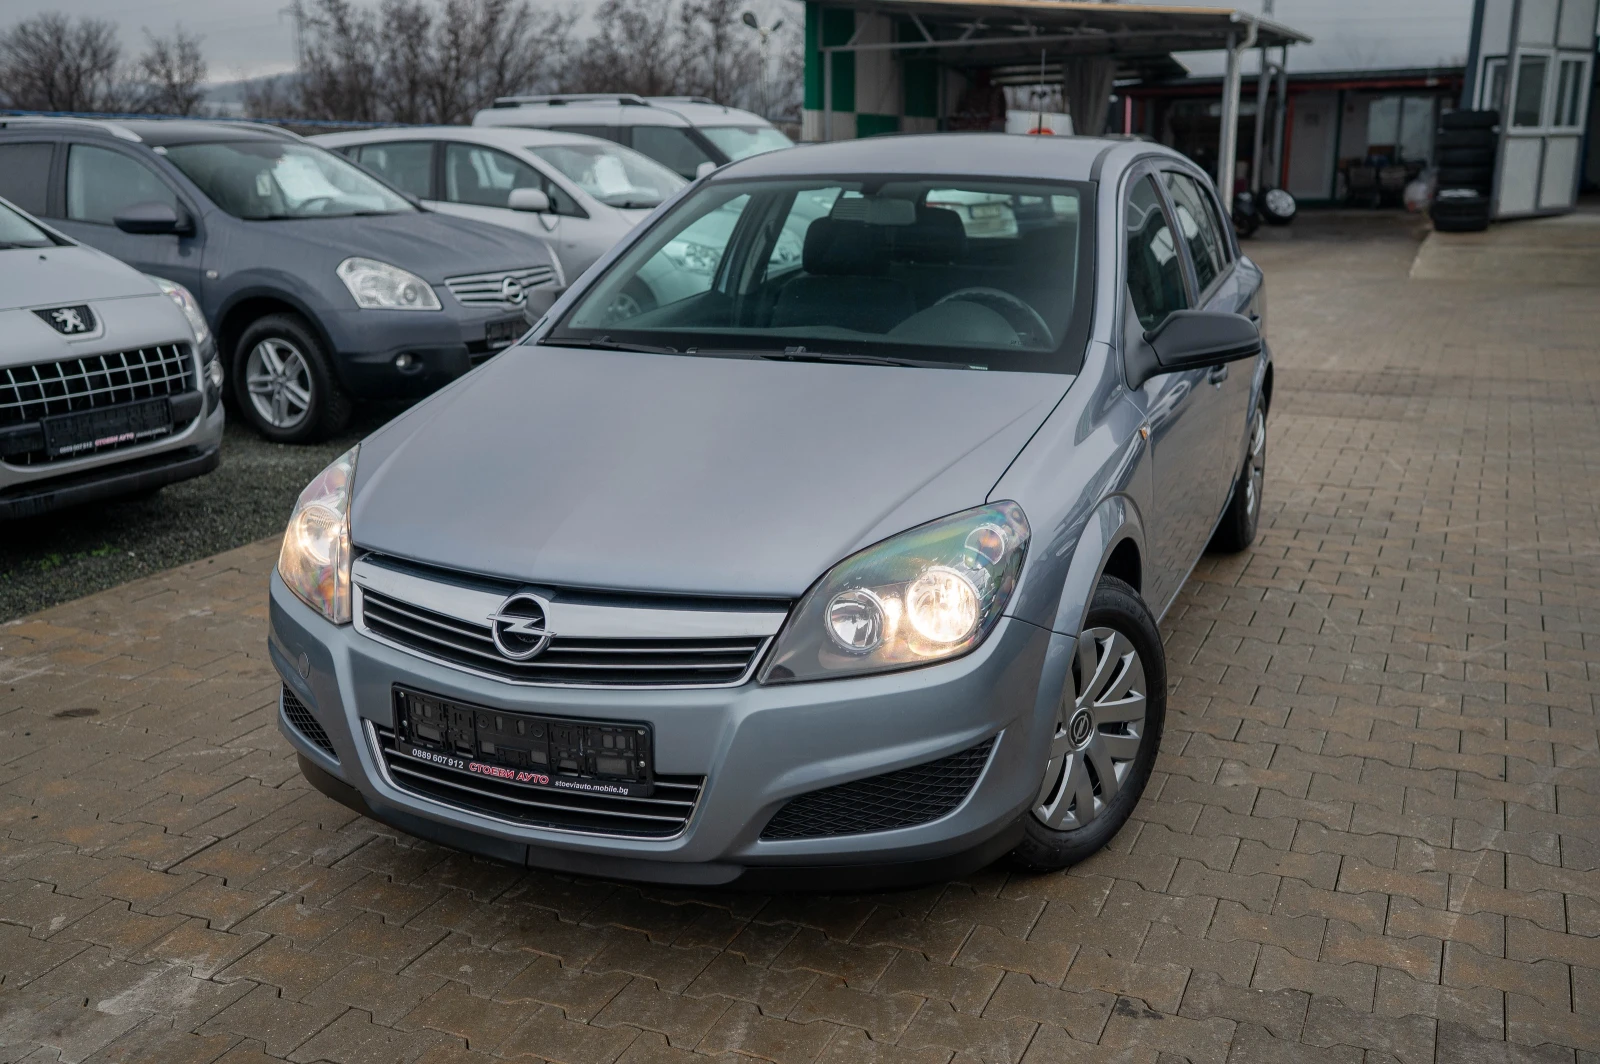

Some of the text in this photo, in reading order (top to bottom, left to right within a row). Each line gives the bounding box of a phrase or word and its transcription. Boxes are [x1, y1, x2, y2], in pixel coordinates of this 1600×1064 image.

[412, 748, 629, 795] 0889 607 912 СТОЕВИ АУТО stoeviauto.mobile.bg
